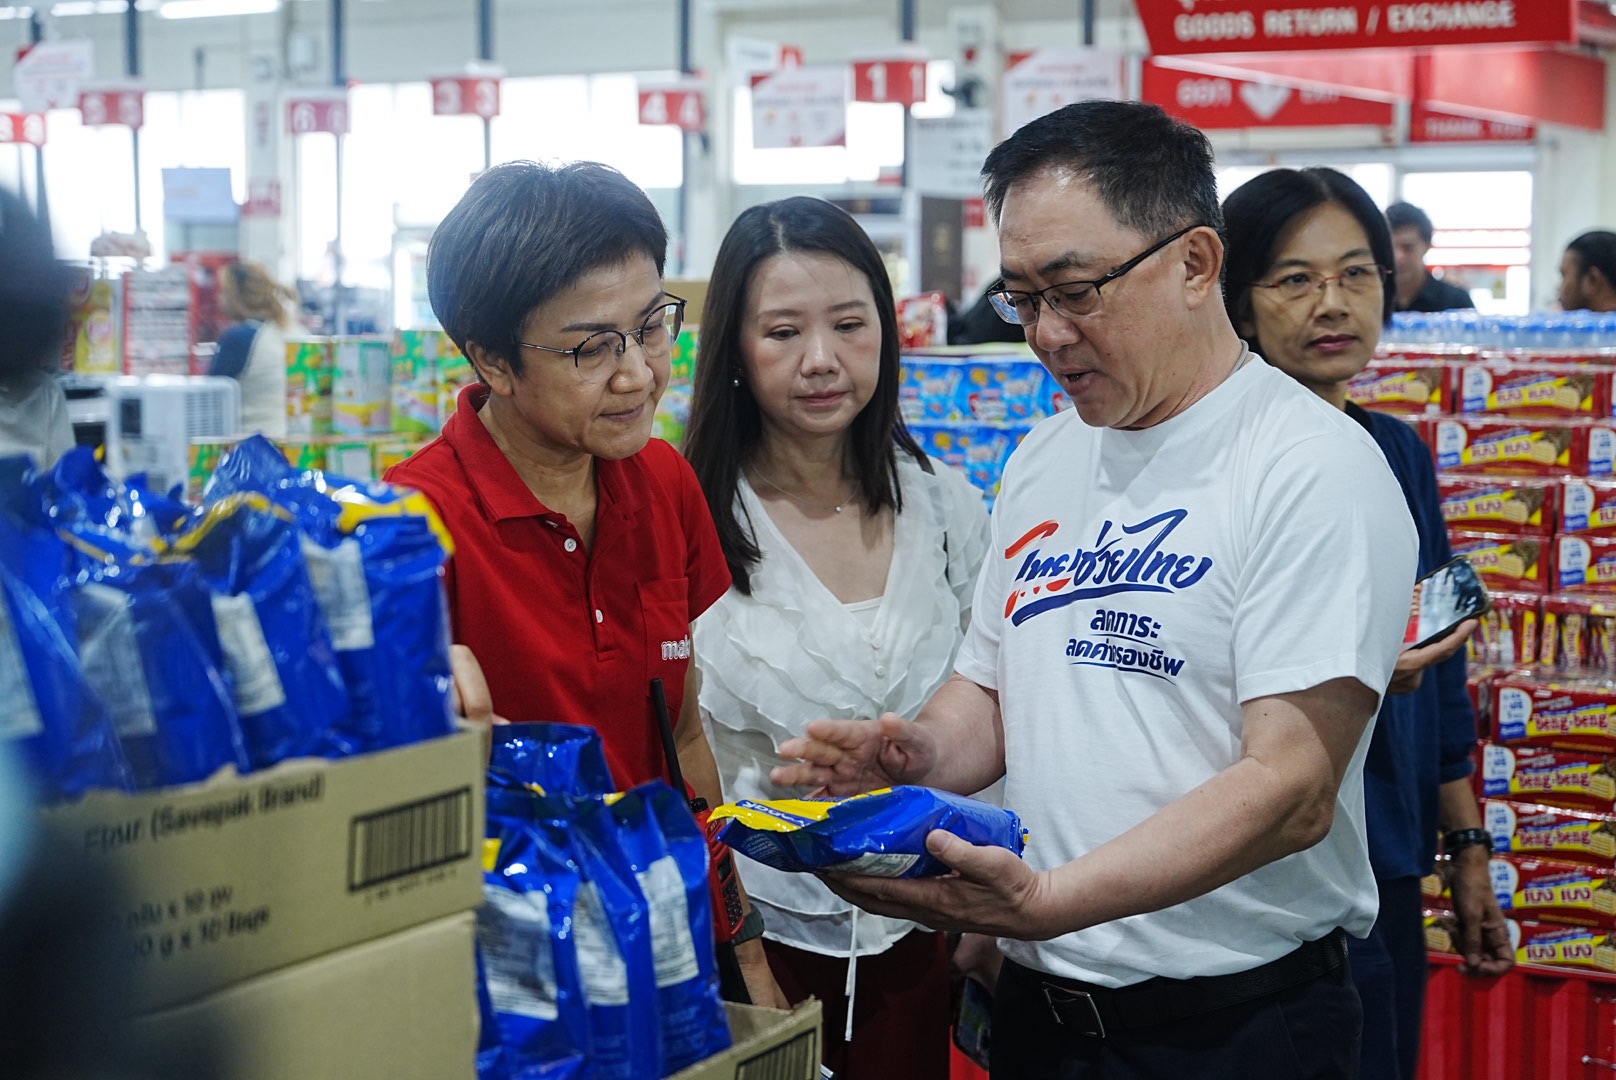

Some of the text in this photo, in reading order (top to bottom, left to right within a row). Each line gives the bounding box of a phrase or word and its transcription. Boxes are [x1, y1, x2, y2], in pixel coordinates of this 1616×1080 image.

[1175, 13, 1255, 42] GOODS
[1264, 8, 1358, 38] RETURN
[1386, 4, 1516, 33] EXCHANGE
[435, 80, 498, 117] 3 3
[866, 66, 887, 102] 1
[641, 92, 702, 127] 4 4
[1089, 609, 1162, 639] ลดภาระ
[1524, 886, 1592, 905] เบง เบง
[1527, 943, 1594, 961] เบง เบง
